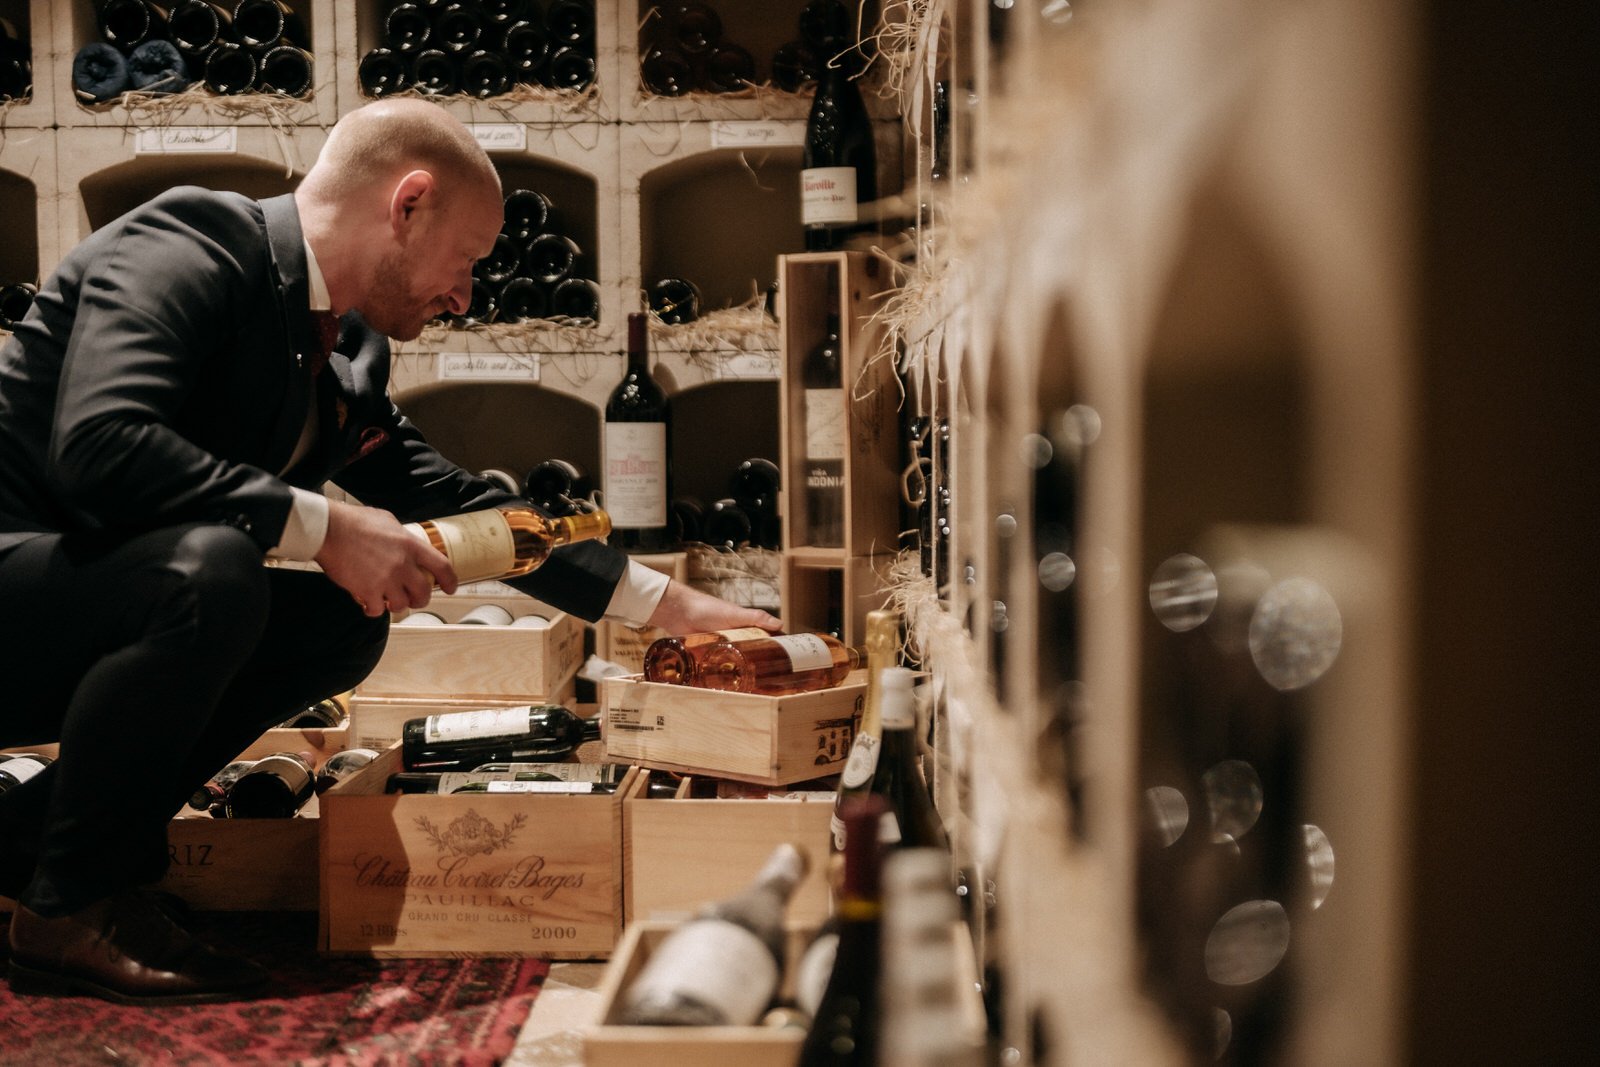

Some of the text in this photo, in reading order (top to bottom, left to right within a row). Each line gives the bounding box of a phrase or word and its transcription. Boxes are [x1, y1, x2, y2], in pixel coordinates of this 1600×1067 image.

[167, 844, 214, 866] RIZ
[403, 894, 534, 907] PAUILLAC
[408, 913, 448, 921] GRAND
[456, 913, 480, 921] CRU
[531, 926, 577, 940] 2000
